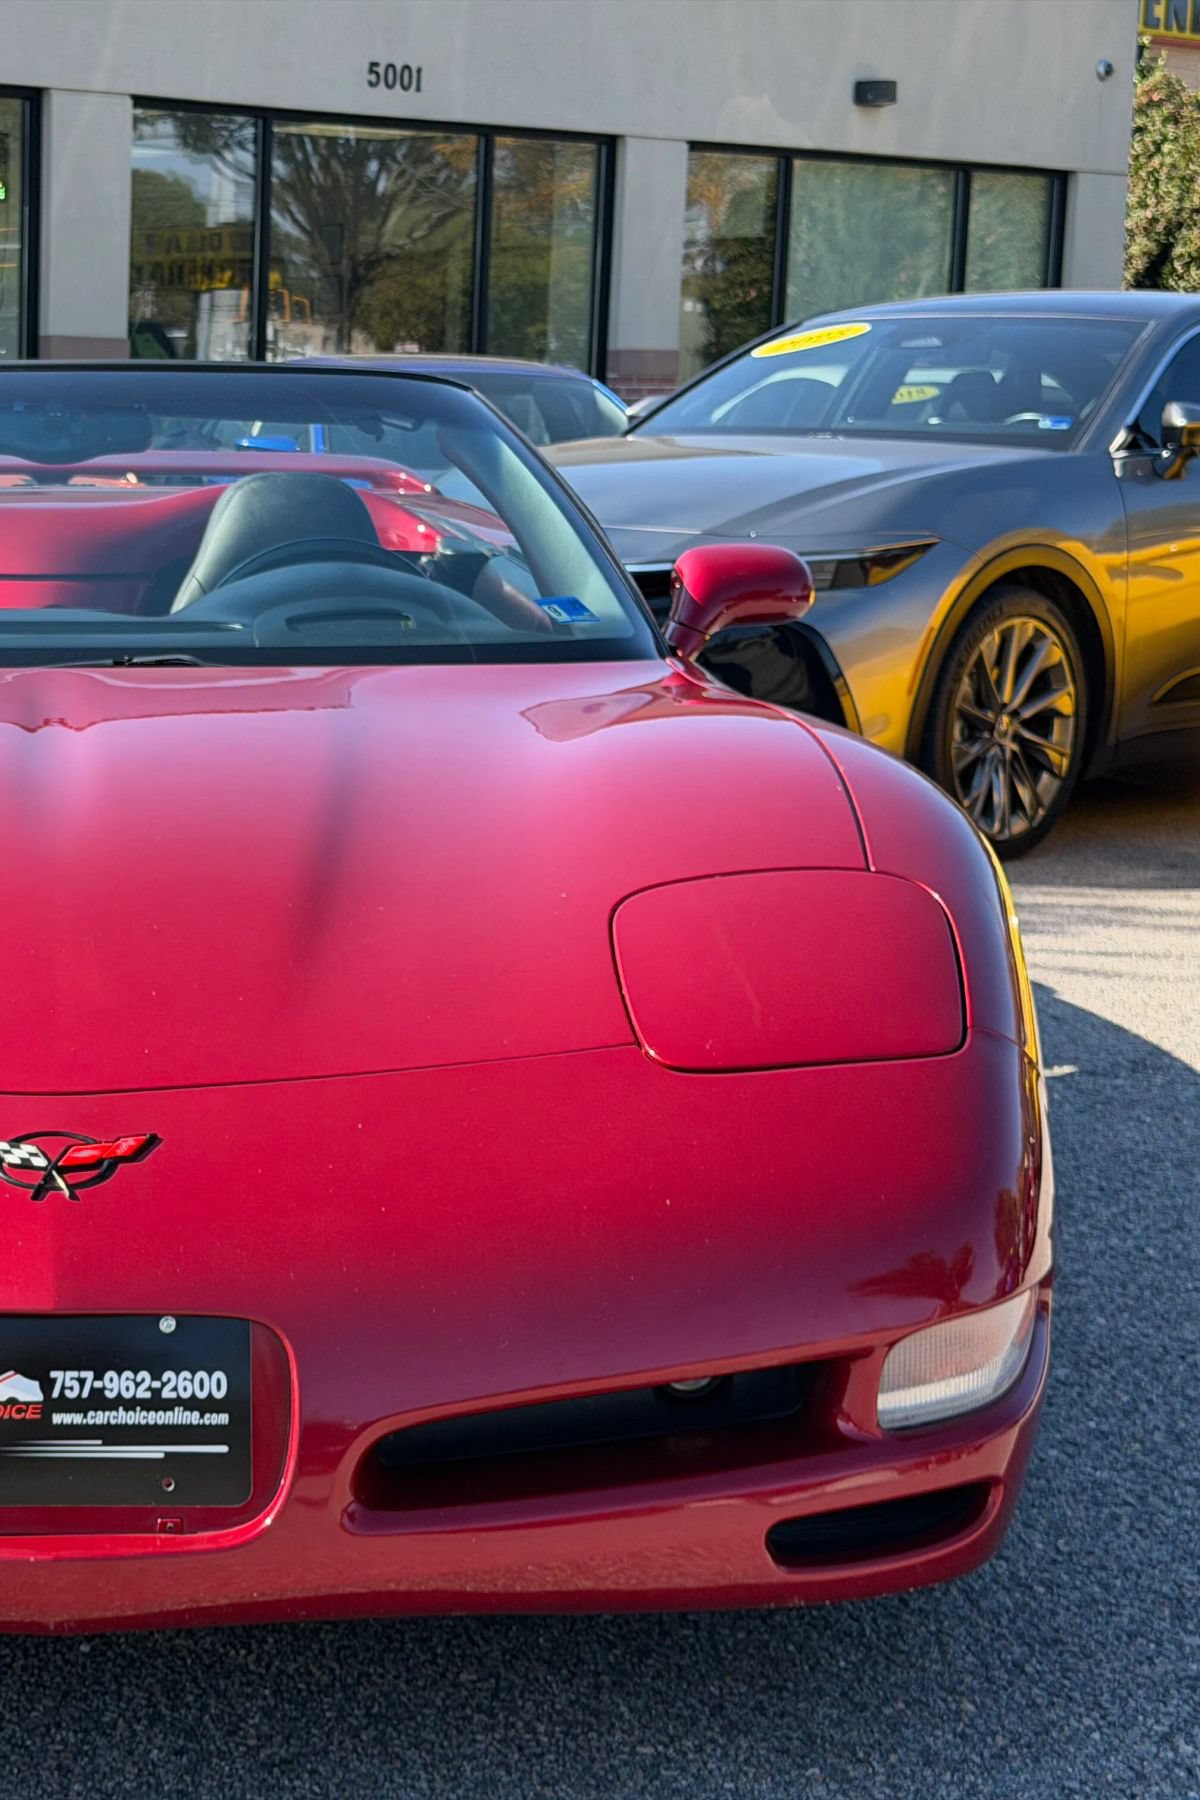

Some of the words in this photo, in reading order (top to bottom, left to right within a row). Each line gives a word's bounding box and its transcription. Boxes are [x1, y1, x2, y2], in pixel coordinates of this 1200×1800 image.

[1144, 0, 1200, 34] EN
[367, 62, 422, 92] 5001
[49, 1370, 228, 1399] 757-962-2600
[51, 1406, 230, 1426] www.carchoiceonline.com
